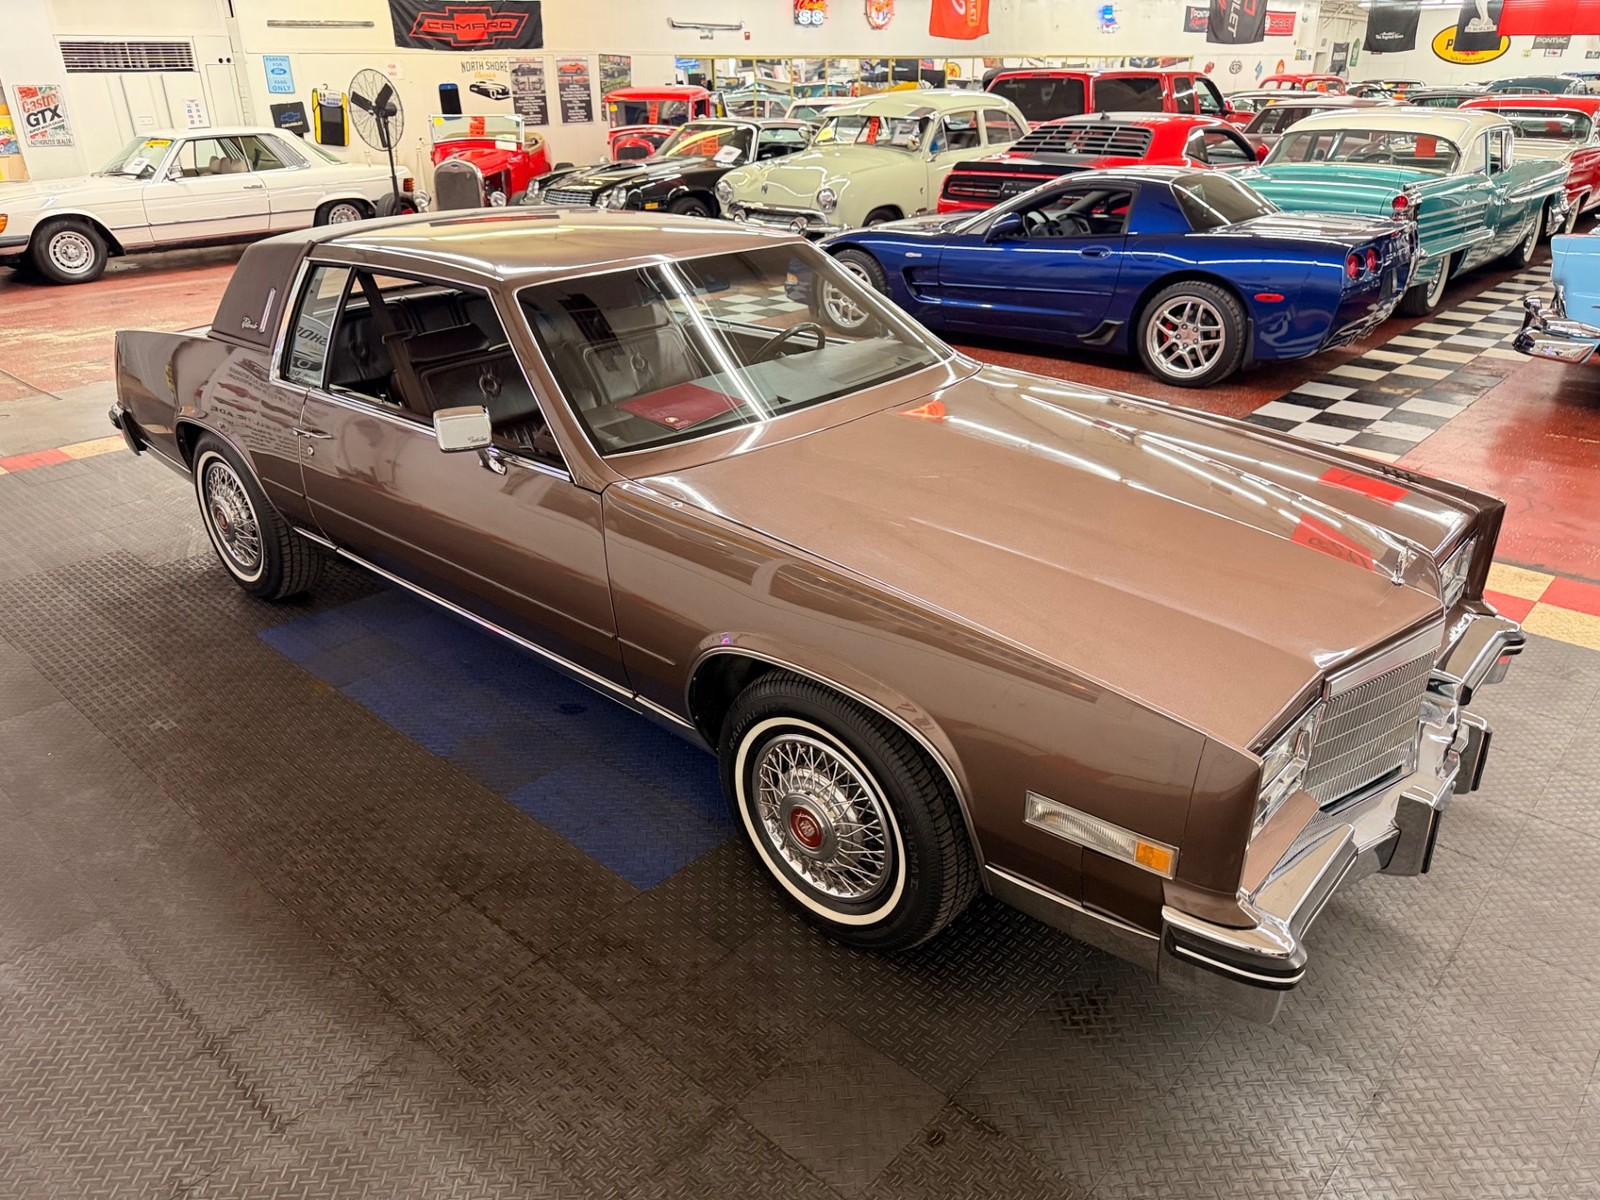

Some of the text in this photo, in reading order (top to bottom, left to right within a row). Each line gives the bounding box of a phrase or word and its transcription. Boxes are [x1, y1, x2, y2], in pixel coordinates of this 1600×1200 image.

[799, 10, 824, 25] SS
[427, 21, 512, 31] CAMARO
[460, 61, 509, 73] NORTH SHORE
[26, 104, 62, 127] GTX
[728, 709, 758, 750] RADIAL
